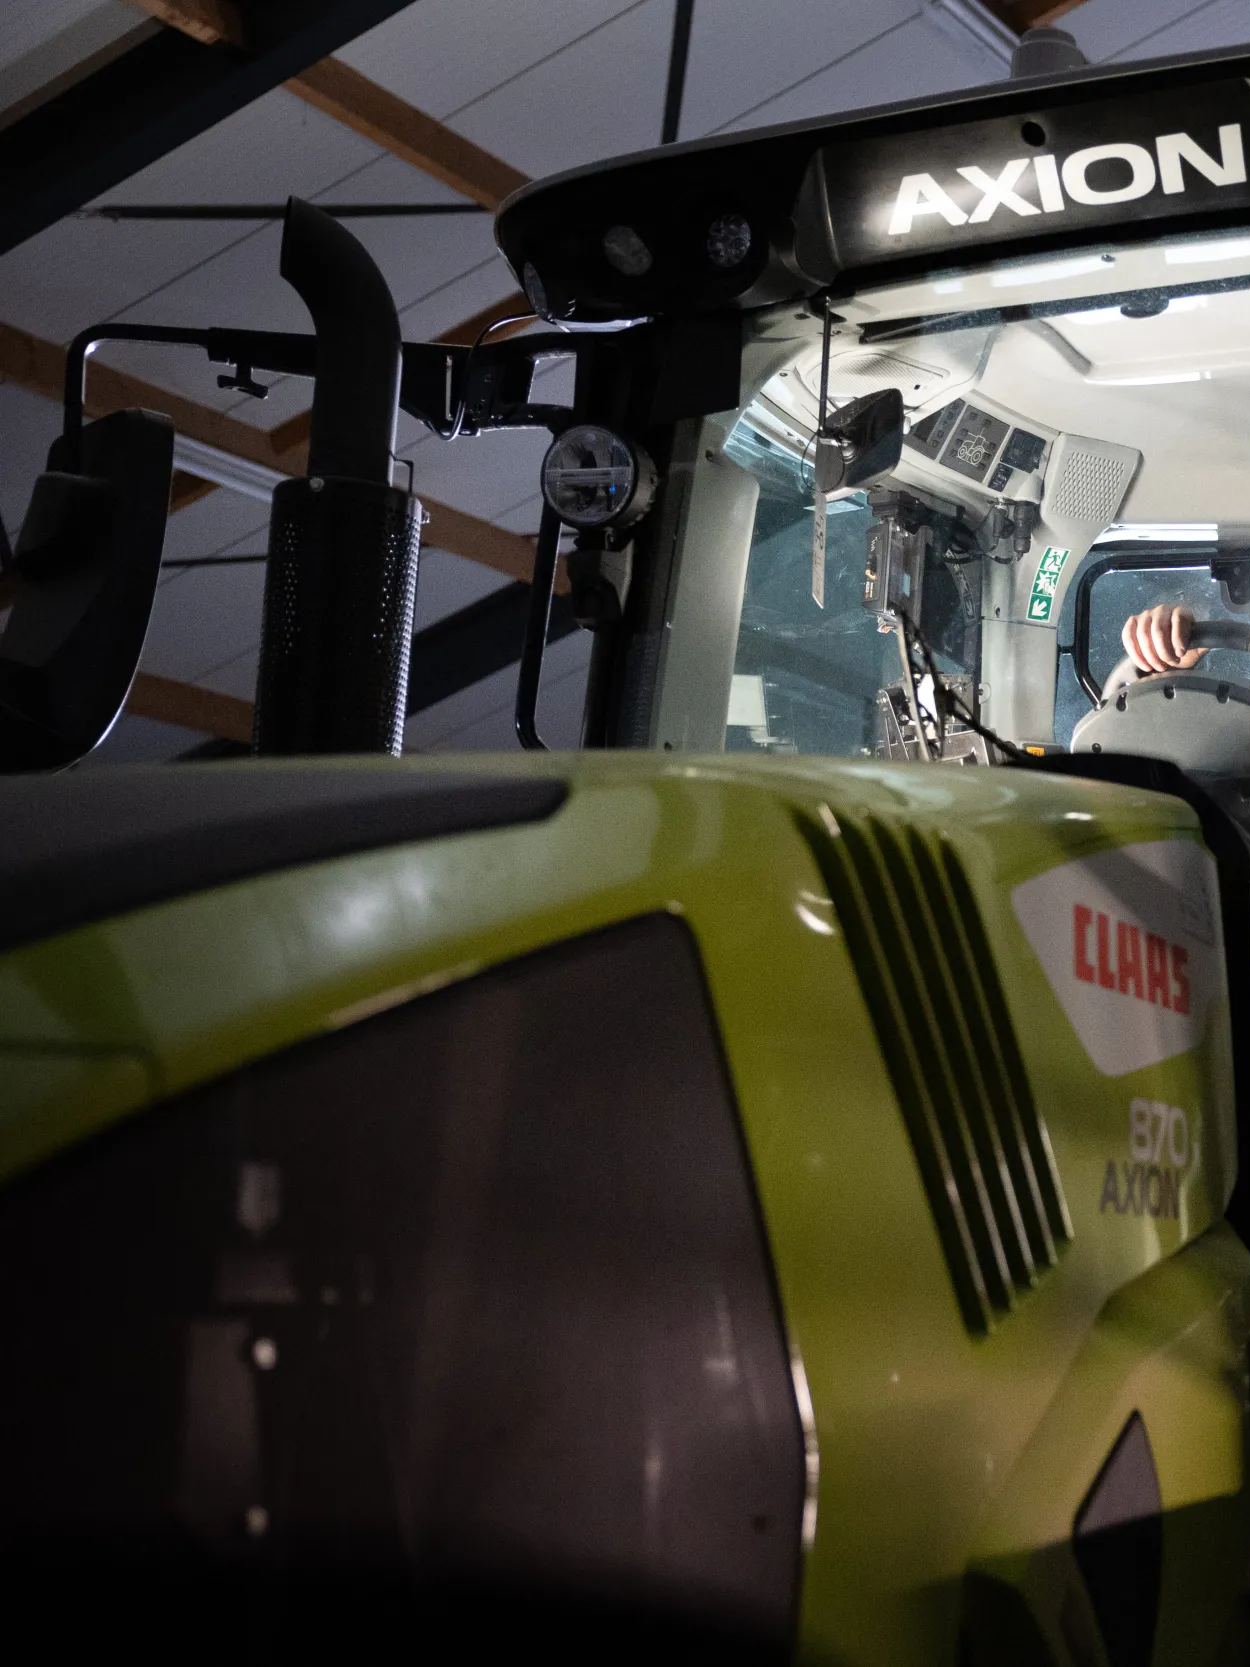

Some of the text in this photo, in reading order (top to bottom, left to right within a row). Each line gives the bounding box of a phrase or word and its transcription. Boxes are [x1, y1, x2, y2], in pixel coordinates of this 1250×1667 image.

[888, 124, 1246, 235] AXION
[1073, 905, 1190, 1014] CLAAS
[1130, 1099, 1188, 1167] 870
[1100, 1158, 1180, 1220] AXION
